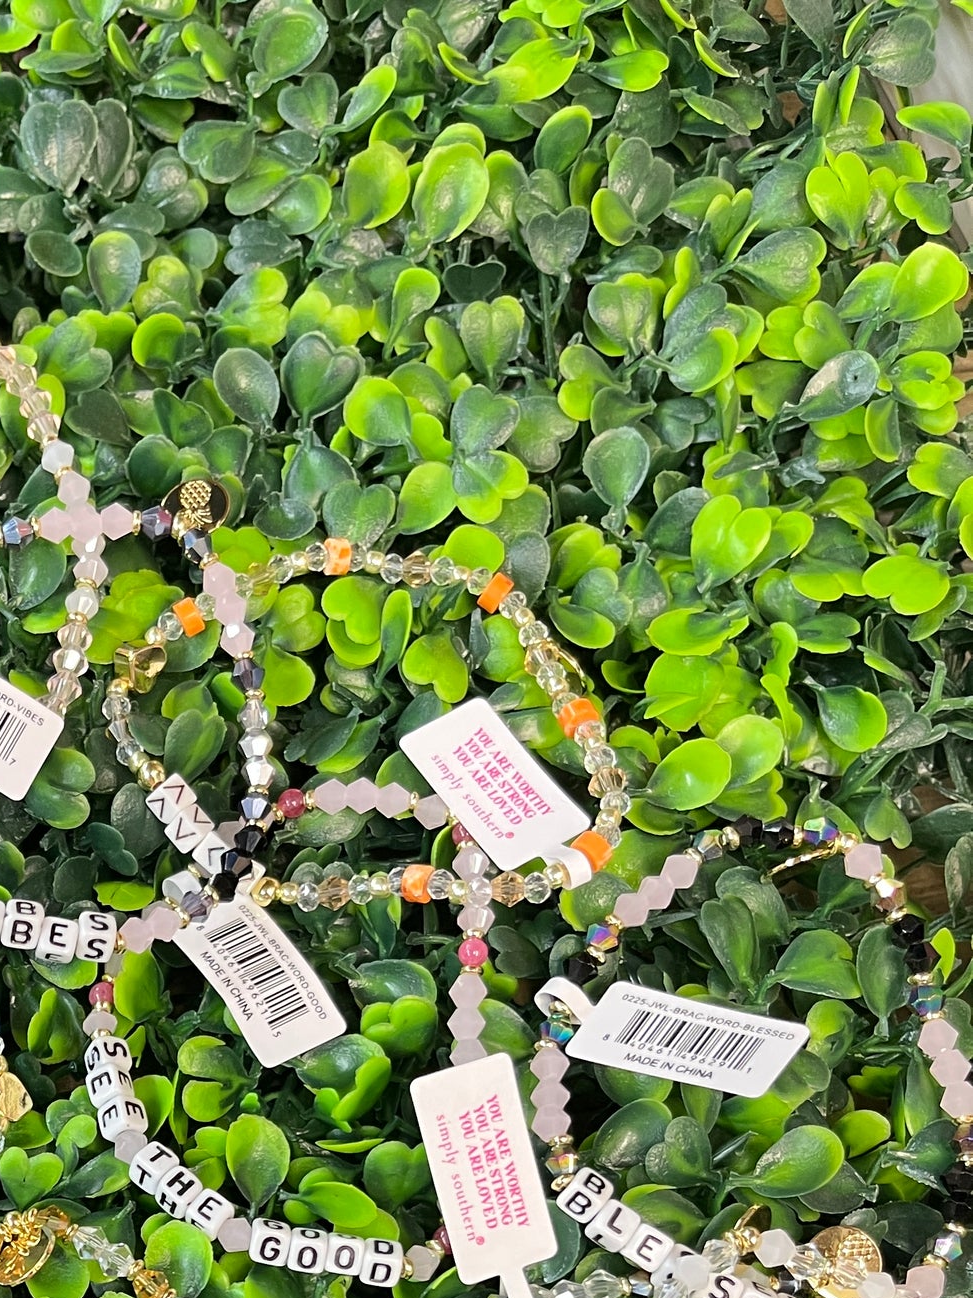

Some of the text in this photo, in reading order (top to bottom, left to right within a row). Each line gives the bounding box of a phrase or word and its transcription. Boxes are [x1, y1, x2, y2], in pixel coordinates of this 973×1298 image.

[431, 755, 463, 791] simply
[453, 747, 522, 826] YOU ARE LOVED
[464, 738, 536, 818] YOU ARE STRONG
[473, 728, 554, 816] YOU ARE WORTHY
[200, 952, 253, 1021] MADE IN CHINA
[239, 905, 327, 1020] 0225-JWL-BRAC-WORD-GOOD
[242, 979, 268, 1015] 49621
[622, 993, 795, 1041] 0225-JWL-BRAC-WORD-BLESSED
[631, 1041, 671, 1057] 40461
[681, 1053, 725, 1067] 49629
[624, 1052, 713, 1079] MADE IN CHINA
[87, 1042, 394, 1282] SEE THE GOOD
[436, 1115, 457, 1166] simply
[458, 1111, 498, 1229] YOU ARE LOVED
[473, 1104, 513, 1226] YOU ARE STRONG
[487, 1094, 530, 1227] YOU ARE WORTHY
